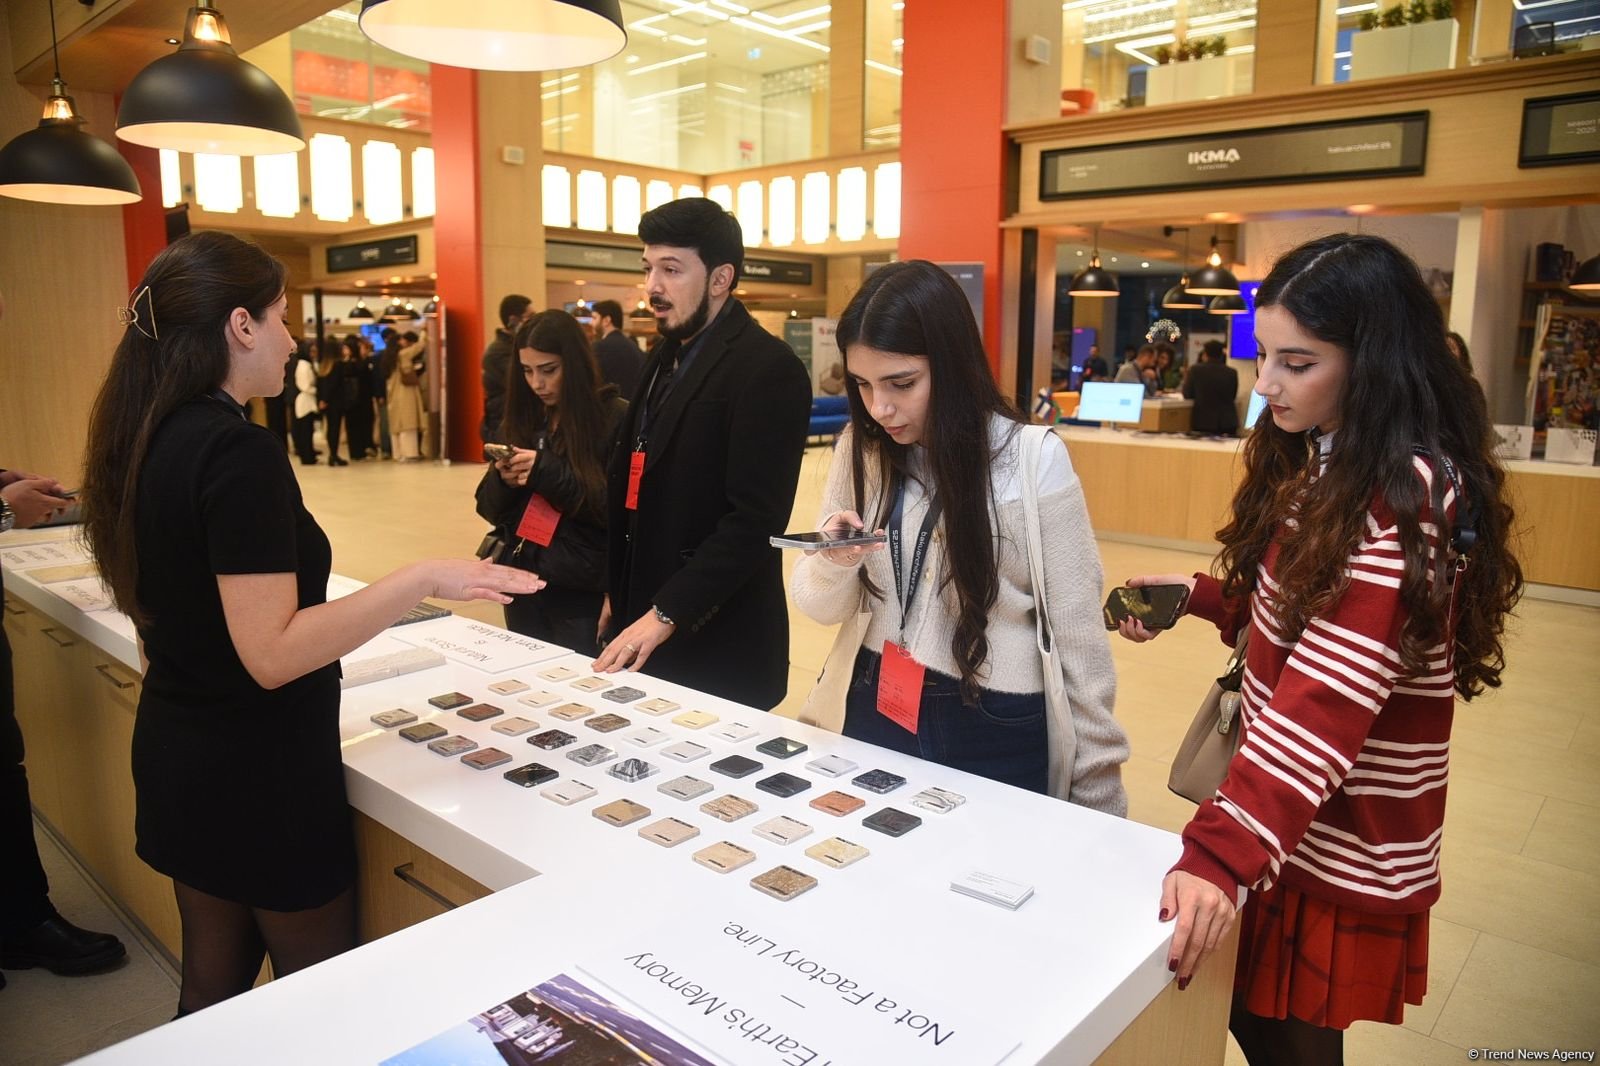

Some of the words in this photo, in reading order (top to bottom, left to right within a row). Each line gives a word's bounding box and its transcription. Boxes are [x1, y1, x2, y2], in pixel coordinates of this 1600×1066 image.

[1188, 148, 1241, 164] IKMA
[723, 921, 777, 956] Line.
[624, 952, 727, 1016] Memory
[772, 949, 874, 1006] Factory
[874, 997, 897, 1012] a
[723, 1008, 818, 1066] Earth's
[894, 1008, 955, 1046] Not
